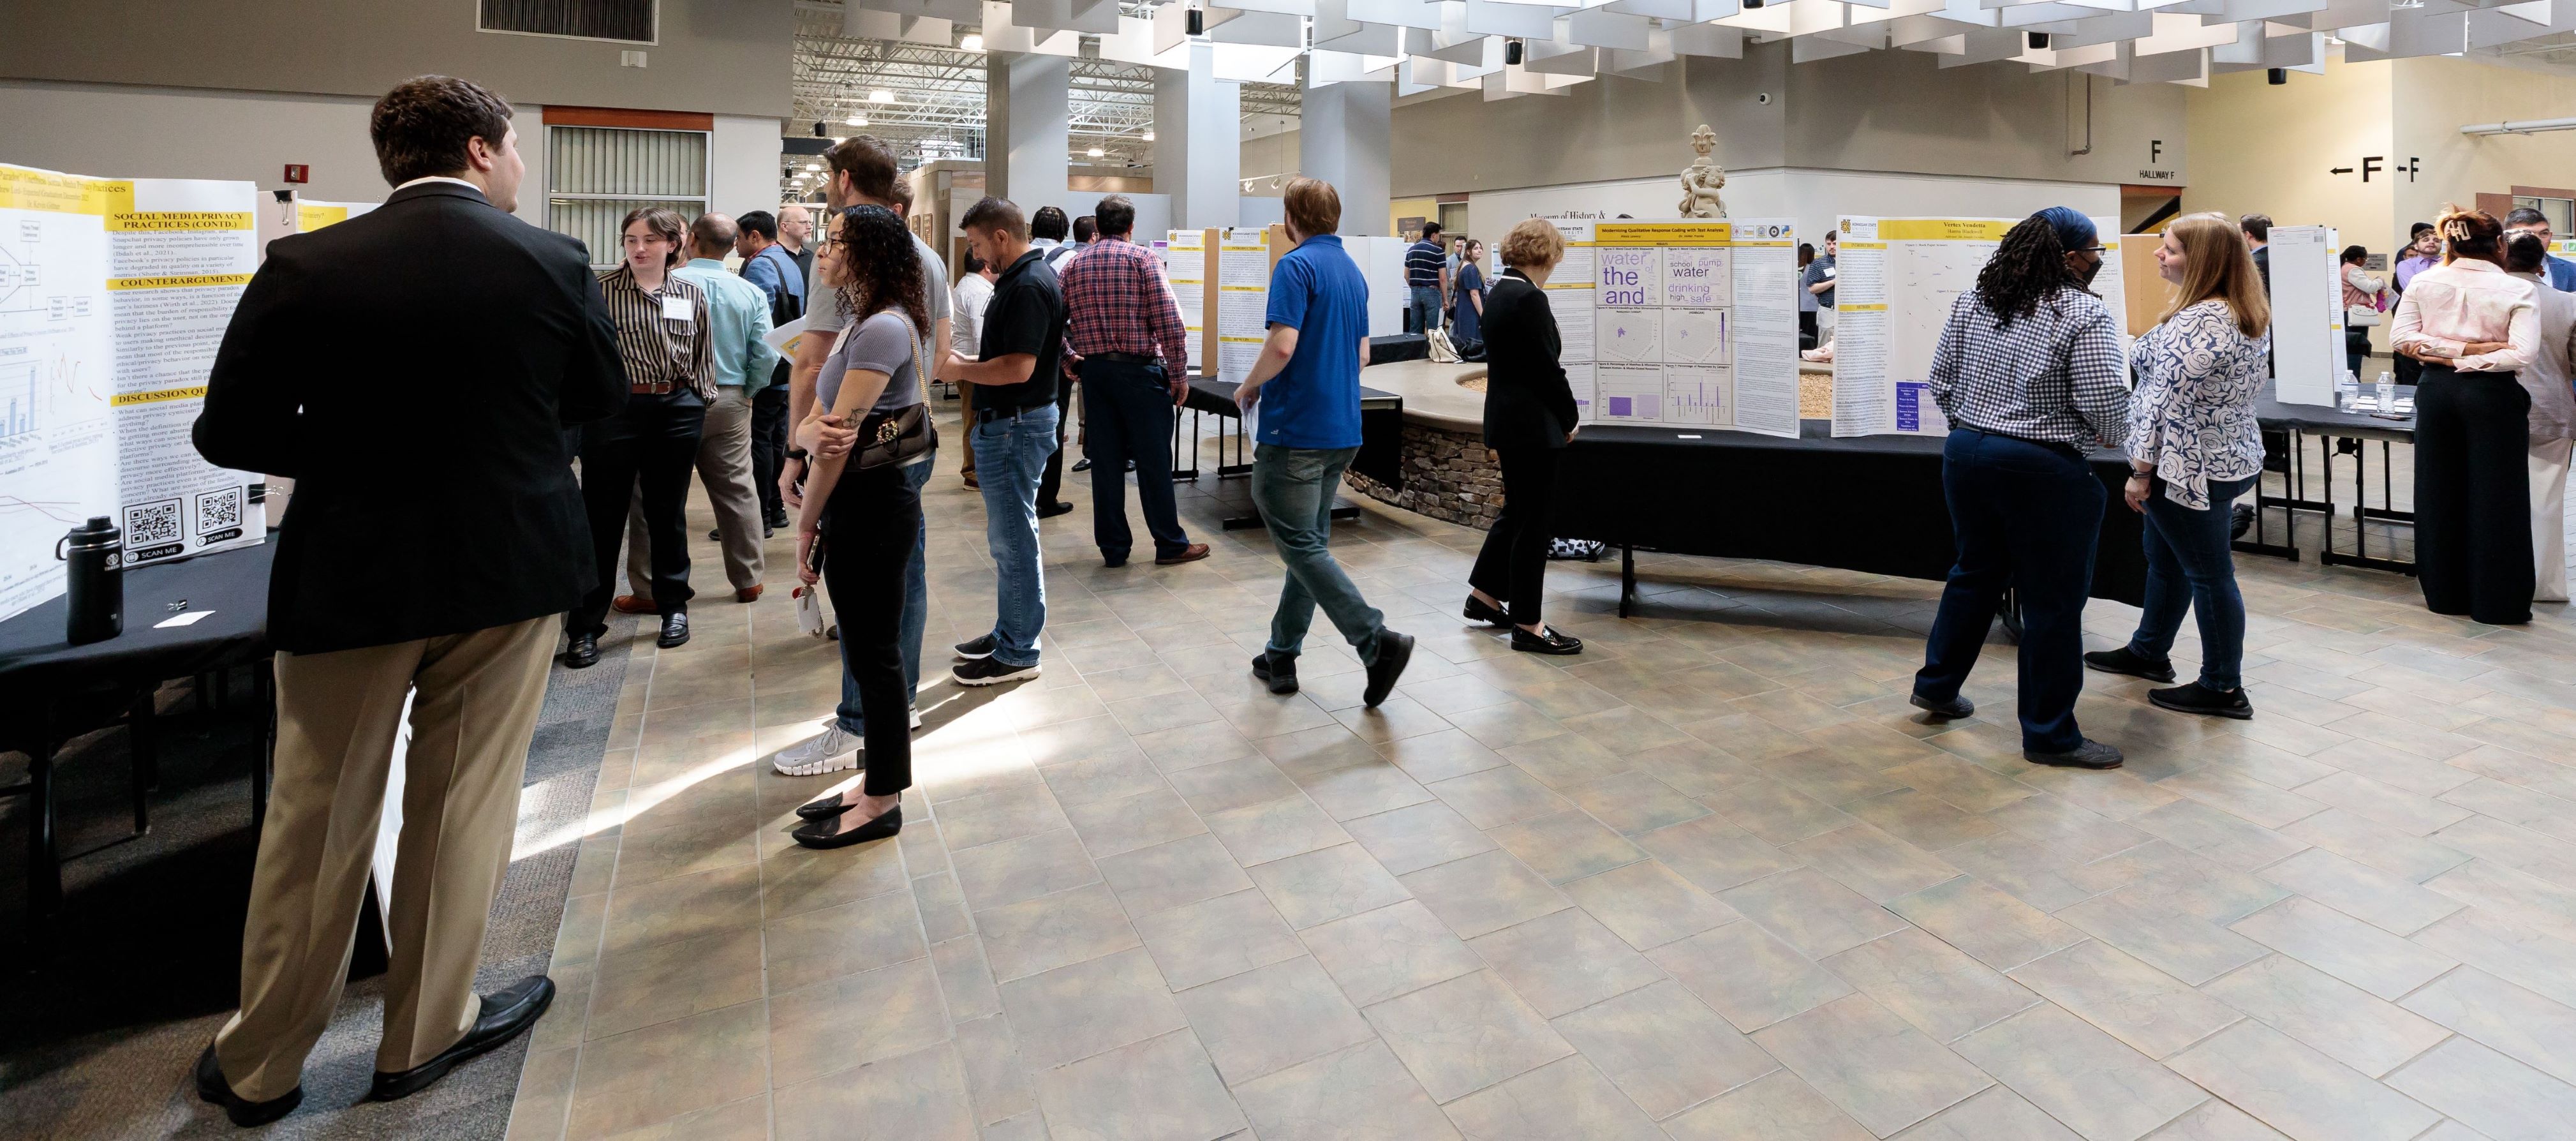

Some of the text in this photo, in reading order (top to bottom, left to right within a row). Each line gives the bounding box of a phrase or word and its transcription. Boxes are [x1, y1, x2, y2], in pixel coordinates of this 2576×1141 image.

[2152, 140, 2161, 163] F
[2140, 170, 2169, 179] HALLWAY
[2363, 156, 2383, 183] F
[2411, 157, 2419, 183] F
[93, 183, 126, 192] Practices
[1561, 211, 1568, 219] of
[1599, 210, 1606, 219] &
[1601, 252, 1647, 265] water
[1603, 266, 1638, 285] the
[1673, 267, 1709, 277] water
[121, 275, 245, 287] COUNTERARGUMENTS
[1669, 283, 1710, 294] drinking
[1606, 287, 1643, 304] and
[1691, 294, 1712, 302] safe
[788, 340, 801, 350] SAVE
[119, 386, 208, 403] DISCUSSION QU
[152, 460, 190, 468] surrounding
[164, 463, 201, 473] effectively?
[208, 534, 223, 542] SCAN
[142, 550, 163, 558] SCAN
